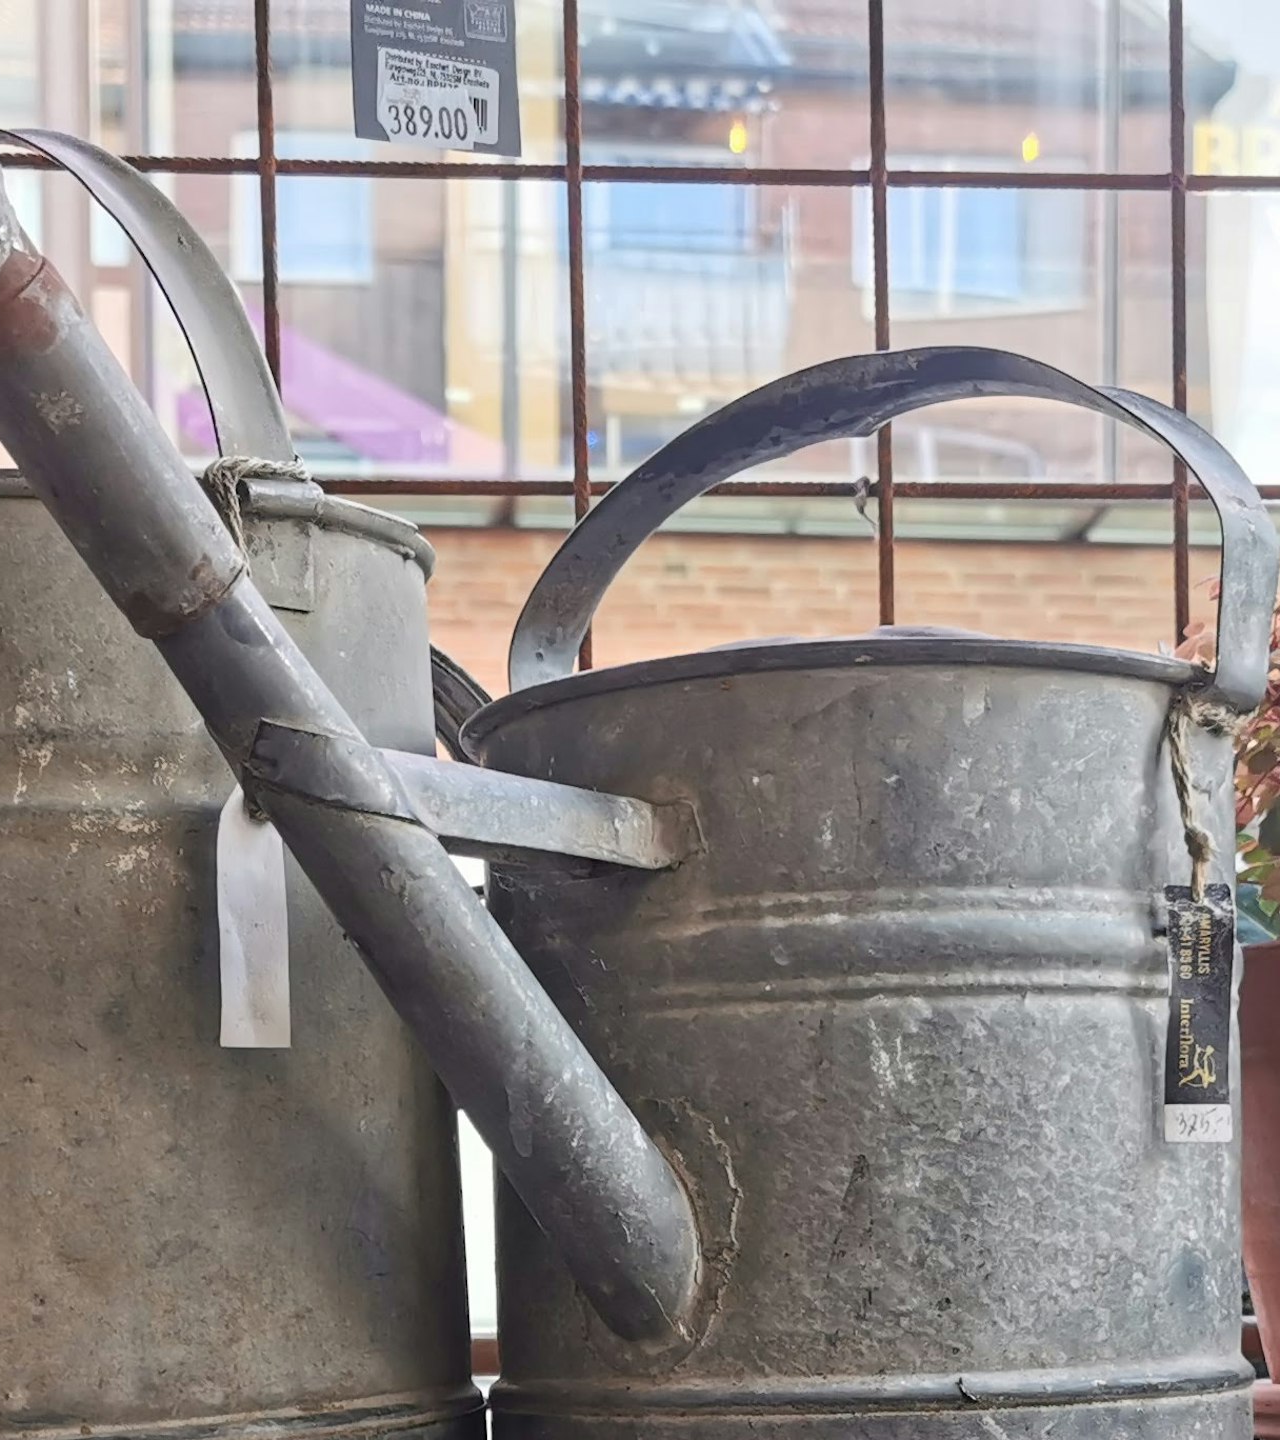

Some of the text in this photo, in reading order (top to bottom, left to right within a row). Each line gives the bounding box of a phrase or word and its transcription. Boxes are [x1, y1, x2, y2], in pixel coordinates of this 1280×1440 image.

[365, 4, 431, 21] MADE IN CHINA
[388, 104, 468, 141] 389.00
[1197, 913, 1212, 975] AMARYLLIS
[1178, 998, 1194, 1069] Interflora
